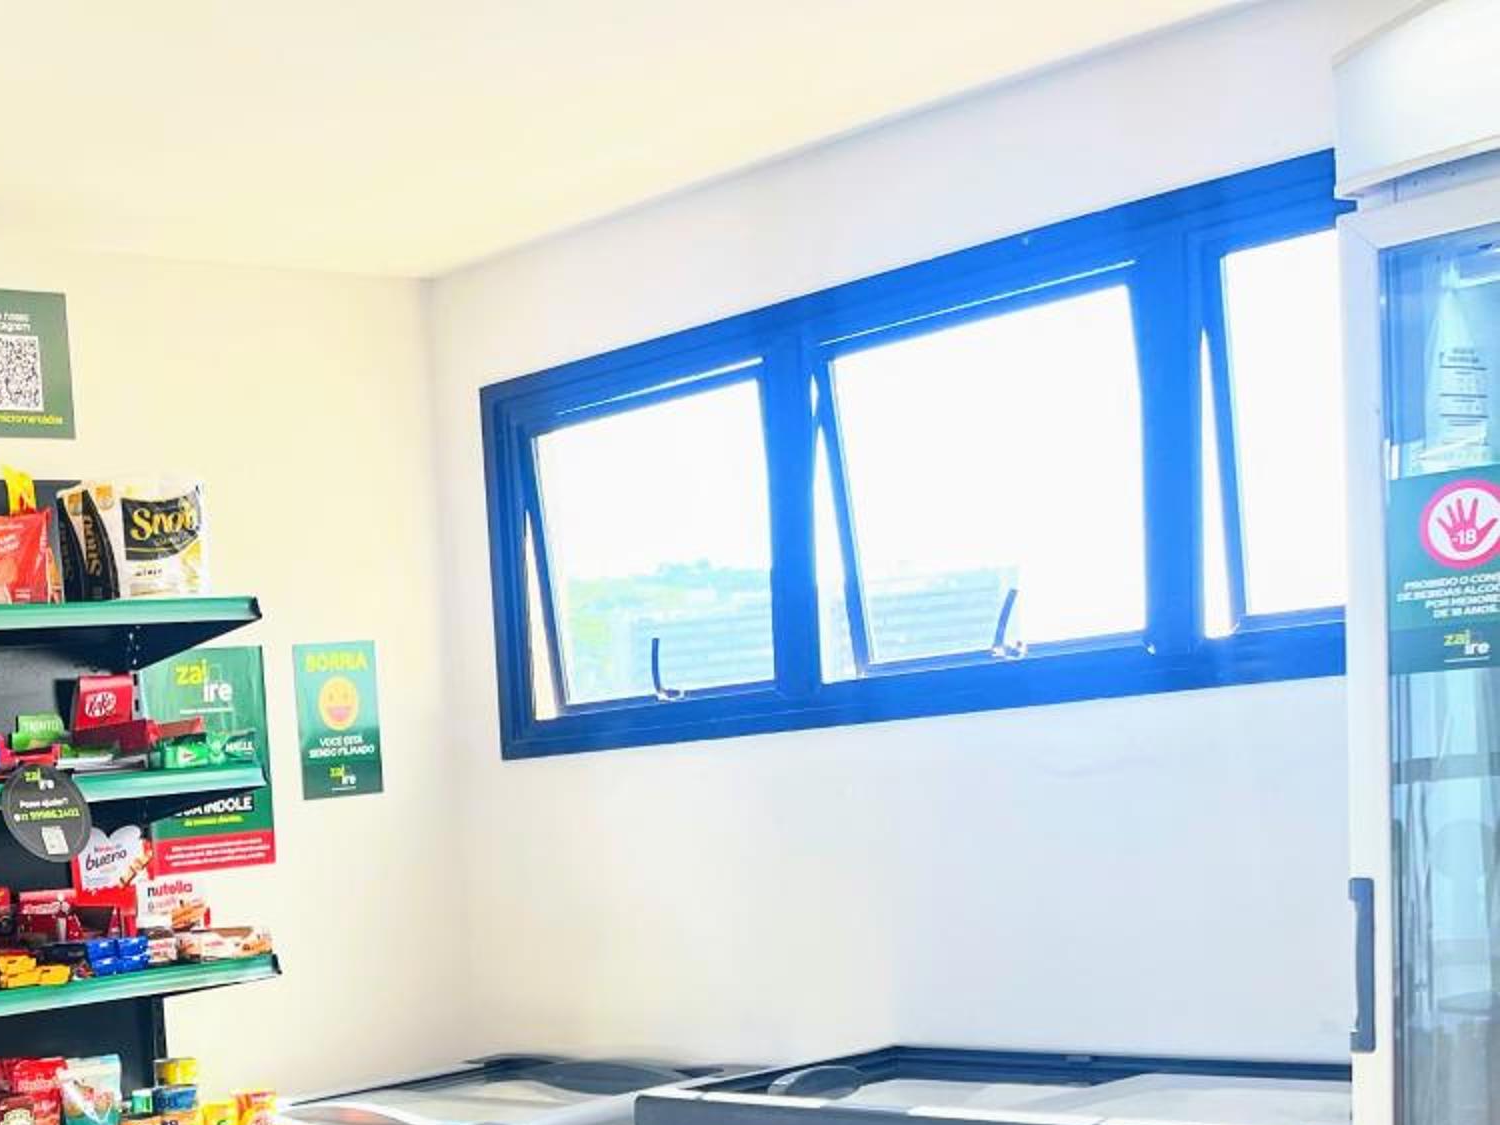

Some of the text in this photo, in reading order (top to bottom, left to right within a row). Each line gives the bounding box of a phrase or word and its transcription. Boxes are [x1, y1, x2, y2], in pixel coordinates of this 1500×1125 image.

[1451, 527, 1478, 545] -18
[85, 849, 128, 872] bueno
[147, 881, 193, 898] nutella
